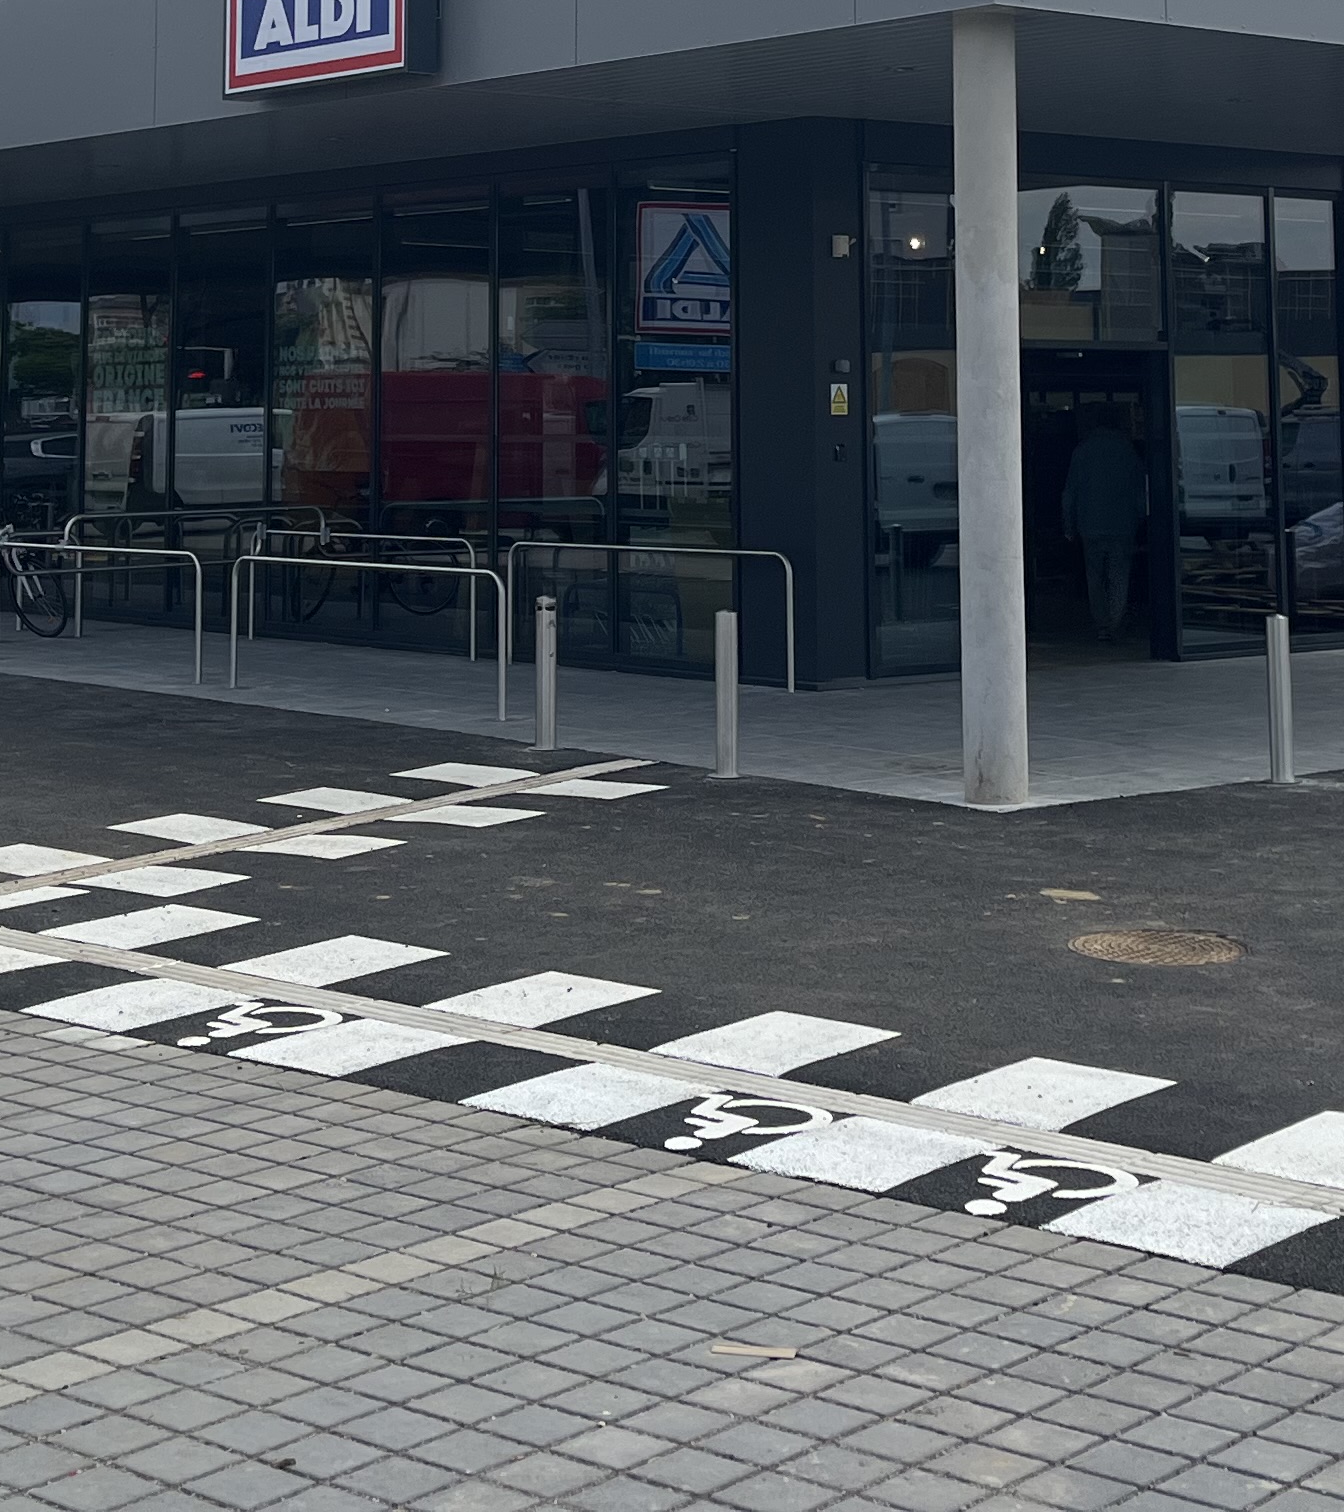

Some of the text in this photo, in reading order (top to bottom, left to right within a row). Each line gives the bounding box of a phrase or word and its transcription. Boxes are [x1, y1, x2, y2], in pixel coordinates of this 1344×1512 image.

[93, 364, 165, 388] ORIGINE
[279, 379, 307, 393] SONT
[308, 378, 345, 393] CUITS
[93, 388, 165, 412] FRANCE
[279, 396, 307, 409] TOUTE
[308, 397, 321, 409] LA
